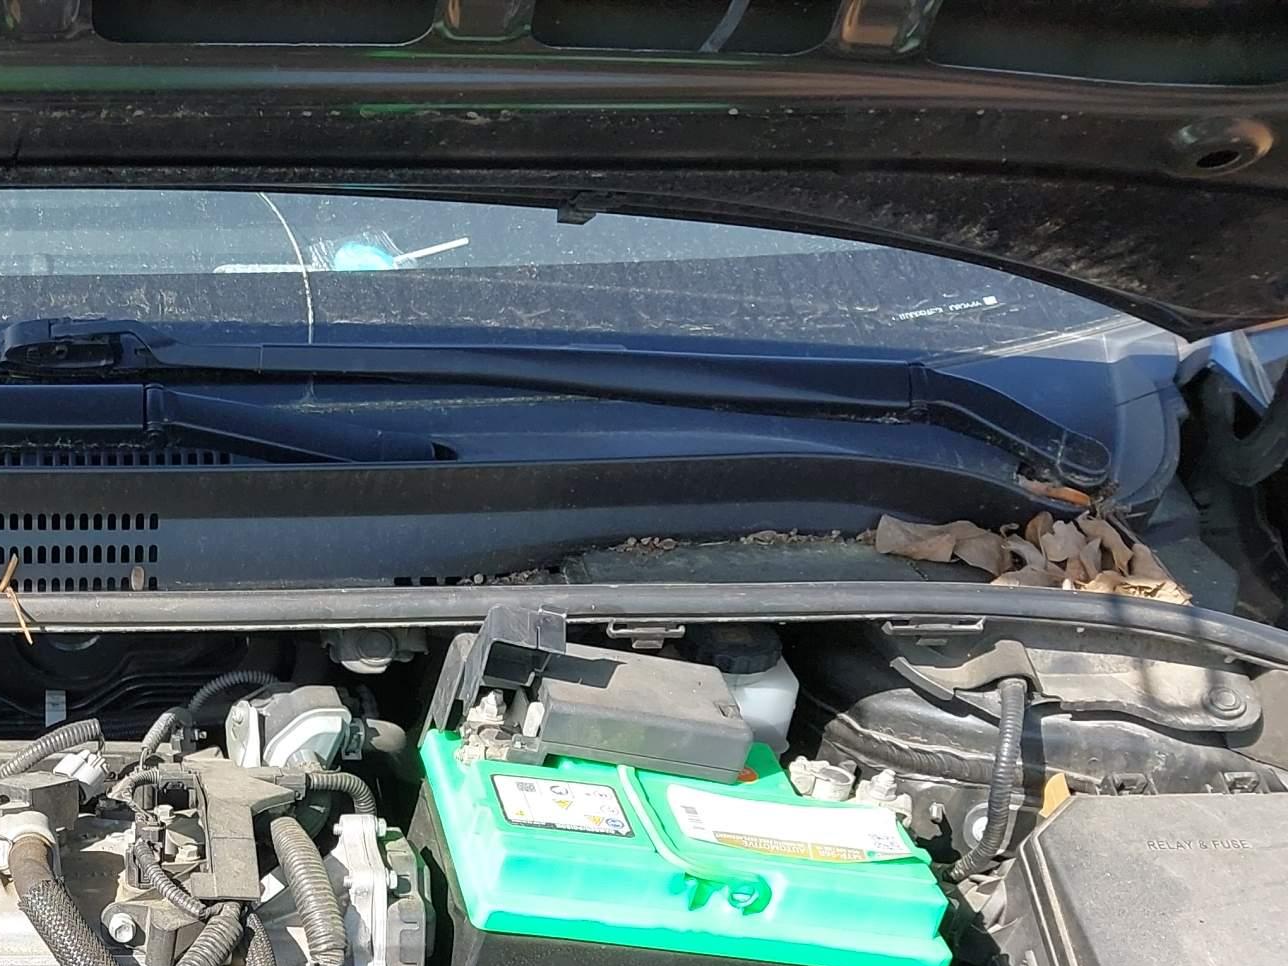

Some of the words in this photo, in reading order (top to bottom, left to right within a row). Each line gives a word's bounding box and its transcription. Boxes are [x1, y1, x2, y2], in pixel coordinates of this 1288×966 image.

[1146, 839, 1193, 850] RELAY
[1198, 839, 1208, 850] &
[1211, 839, 1250, 850] FUSE
